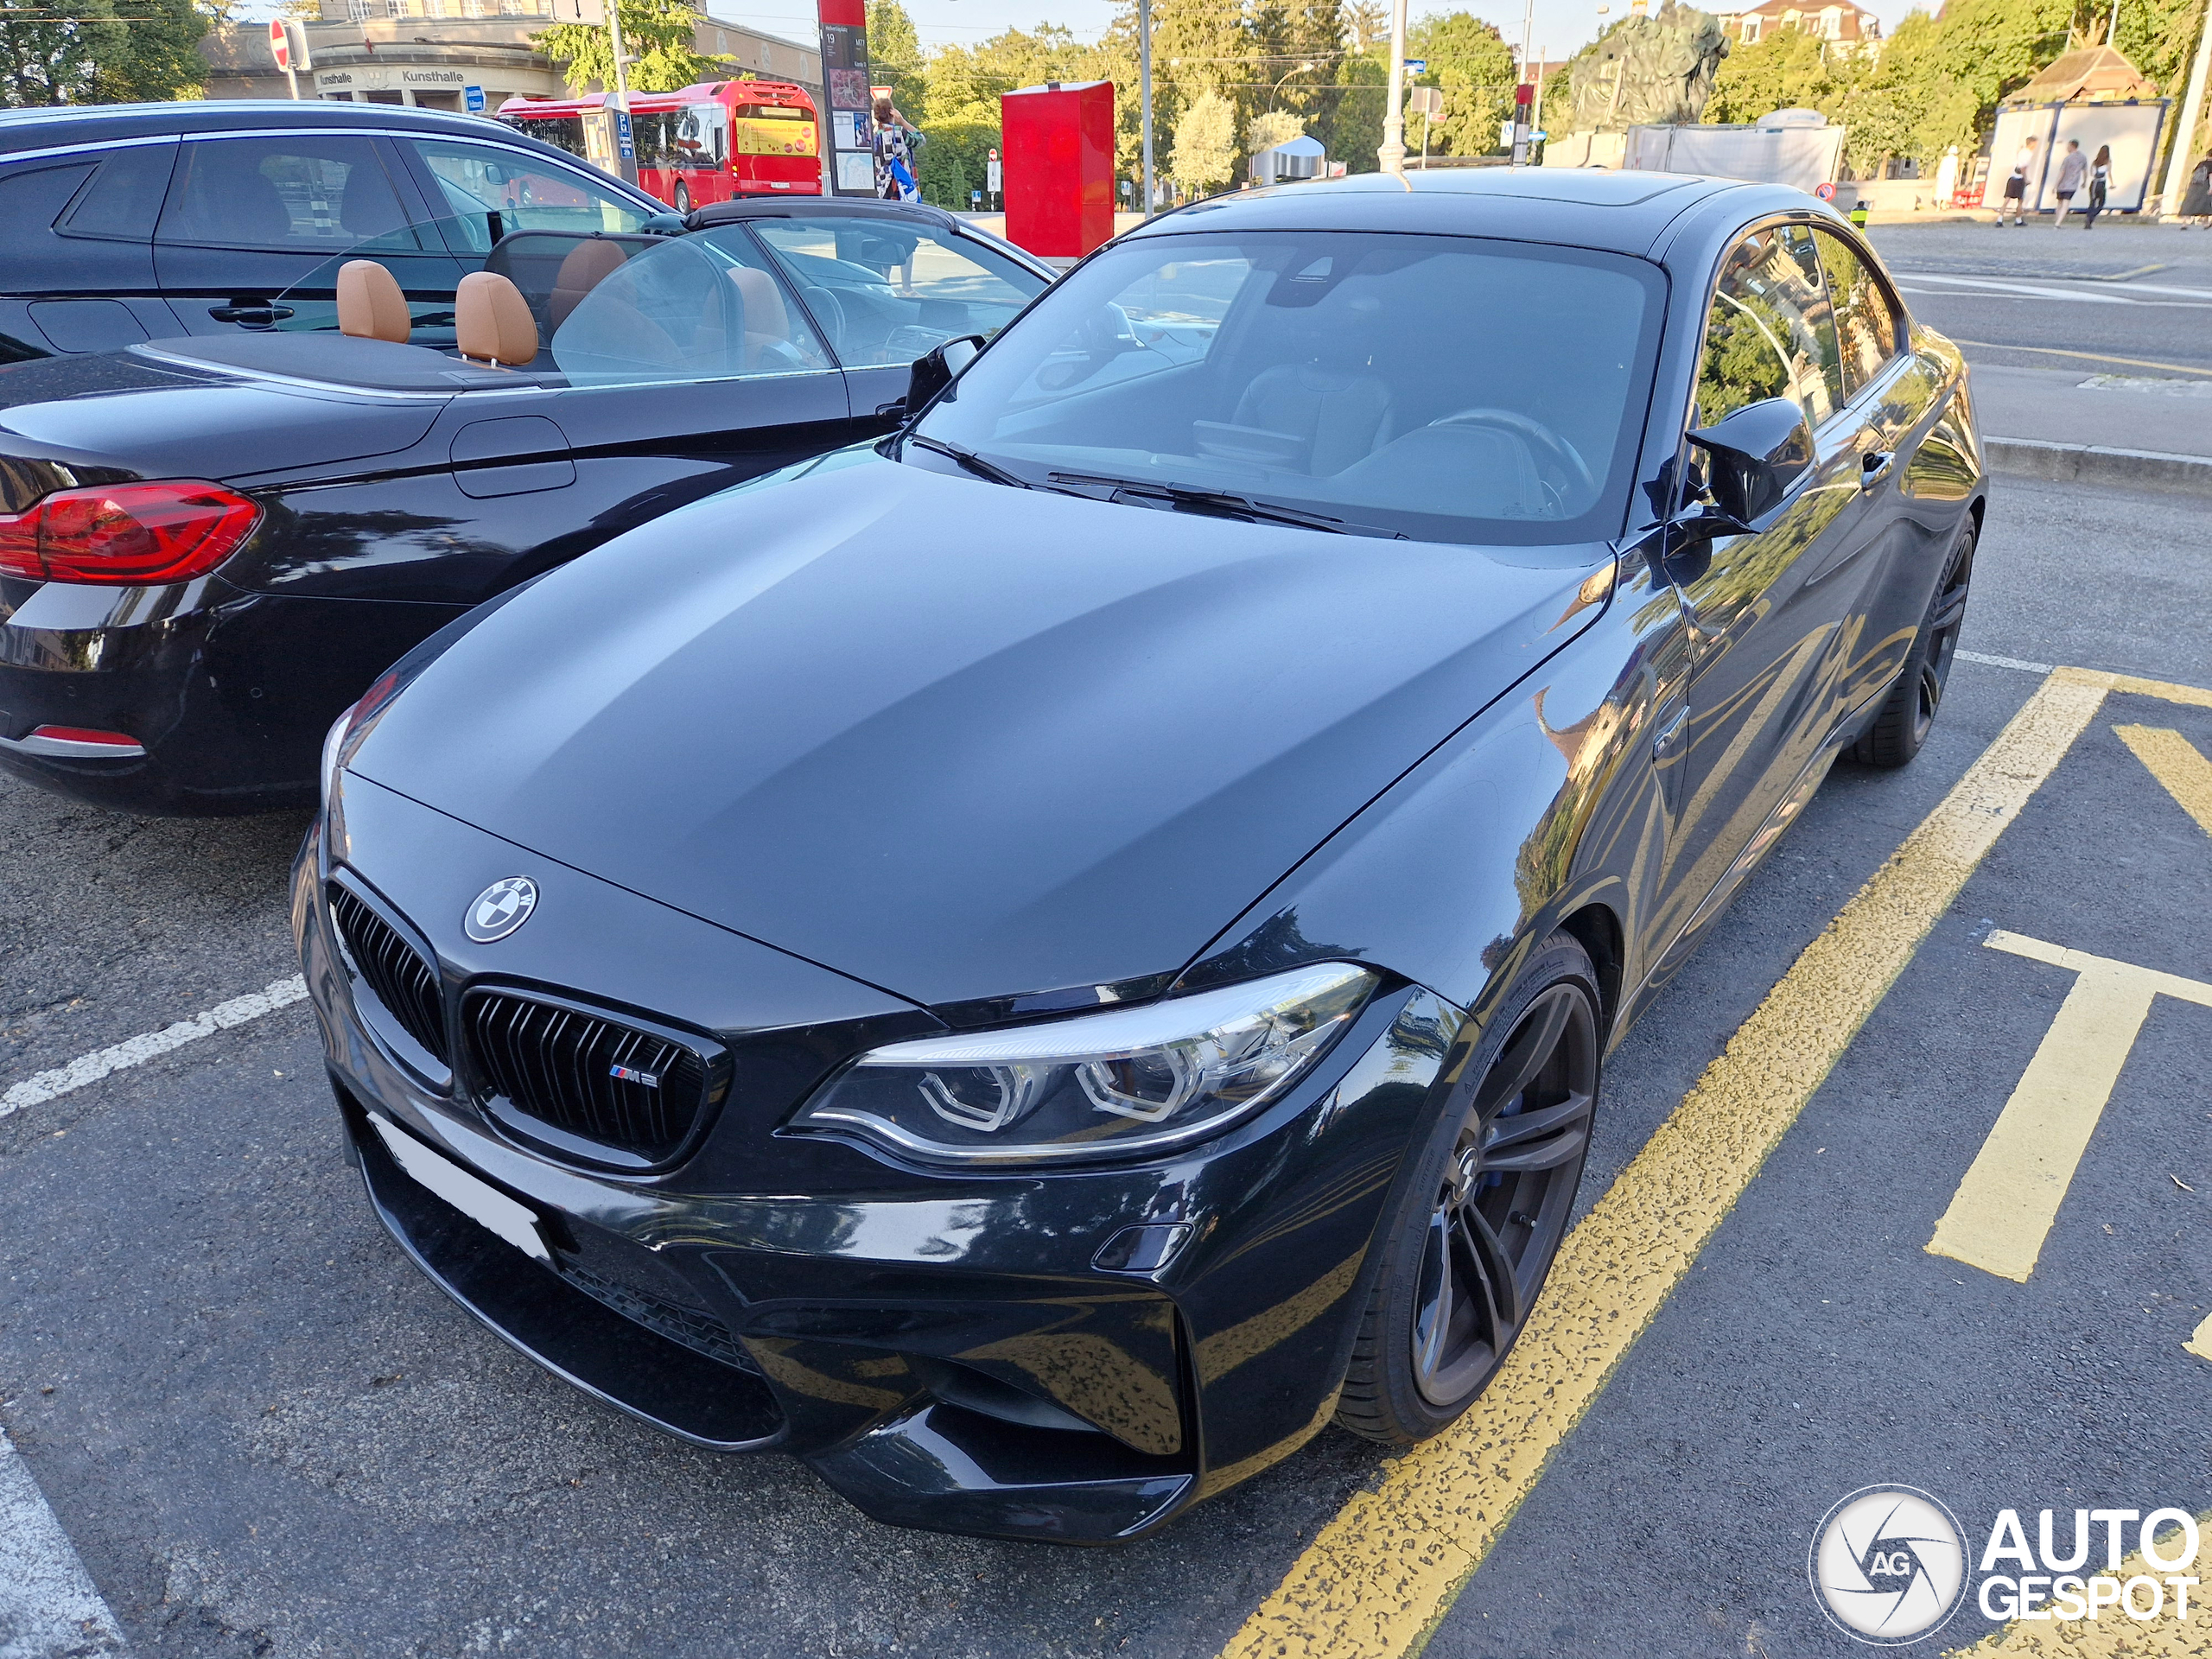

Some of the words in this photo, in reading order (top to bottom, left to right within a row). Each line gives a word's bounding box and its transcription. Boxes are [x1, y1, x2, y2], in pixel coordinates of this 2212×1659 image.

[827, 33, 835, 43] 19
[320, 73, 352, 85] Kunsthalle
[402, 70, 464, 82] Kunsthalle
[620, 114, 626, 124] P
[493, 880, 532, 906] BMW
[622, 1068, 658, 1088] M2
